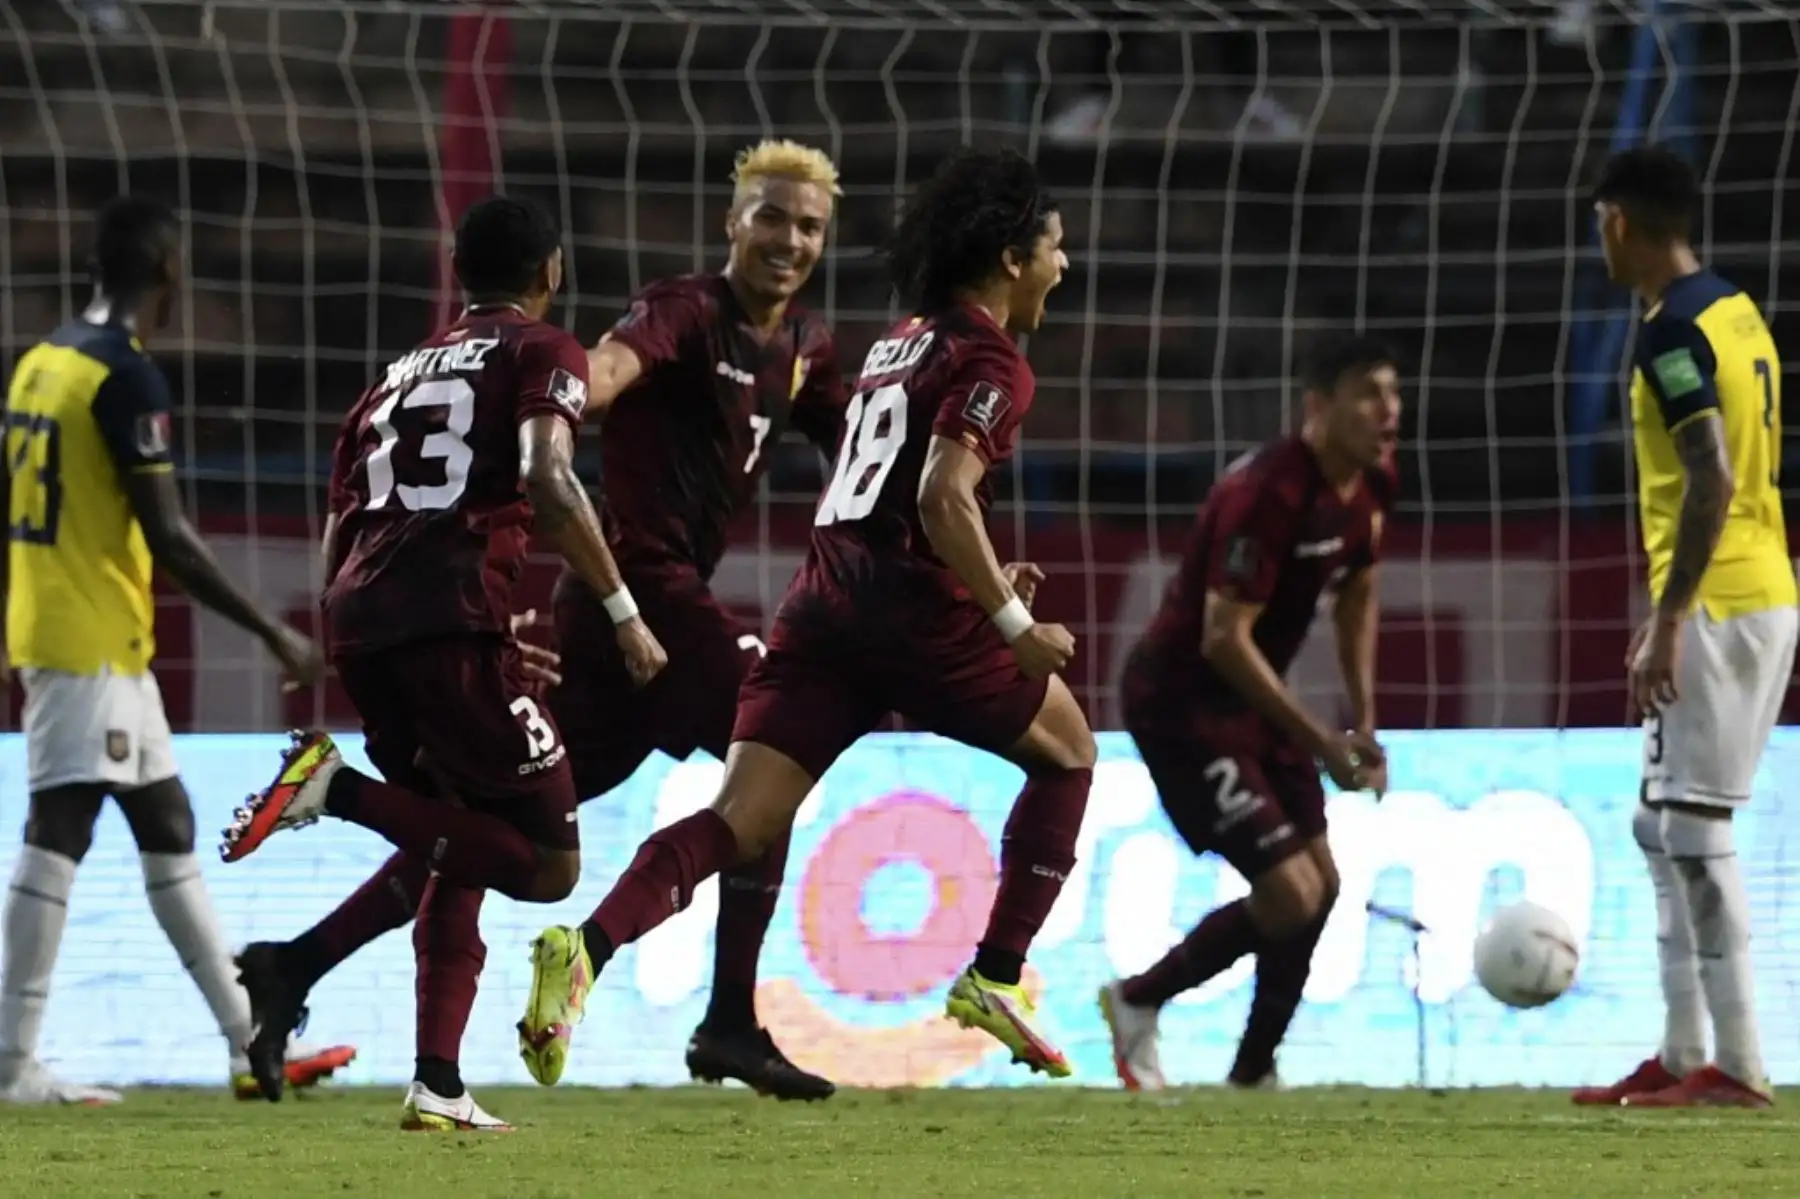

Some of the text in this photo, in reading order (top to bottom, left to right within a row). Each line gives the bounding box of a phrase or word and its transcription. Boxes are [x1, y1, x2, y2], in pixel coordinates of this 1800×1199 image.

[861, 330, 935, 379] BELLO
[364, 377, 475, 512] 13
[743, 413, 771, 473] 7
[814, 382, 908, 526] 18
[1203, 756, 1251, 814] 2
